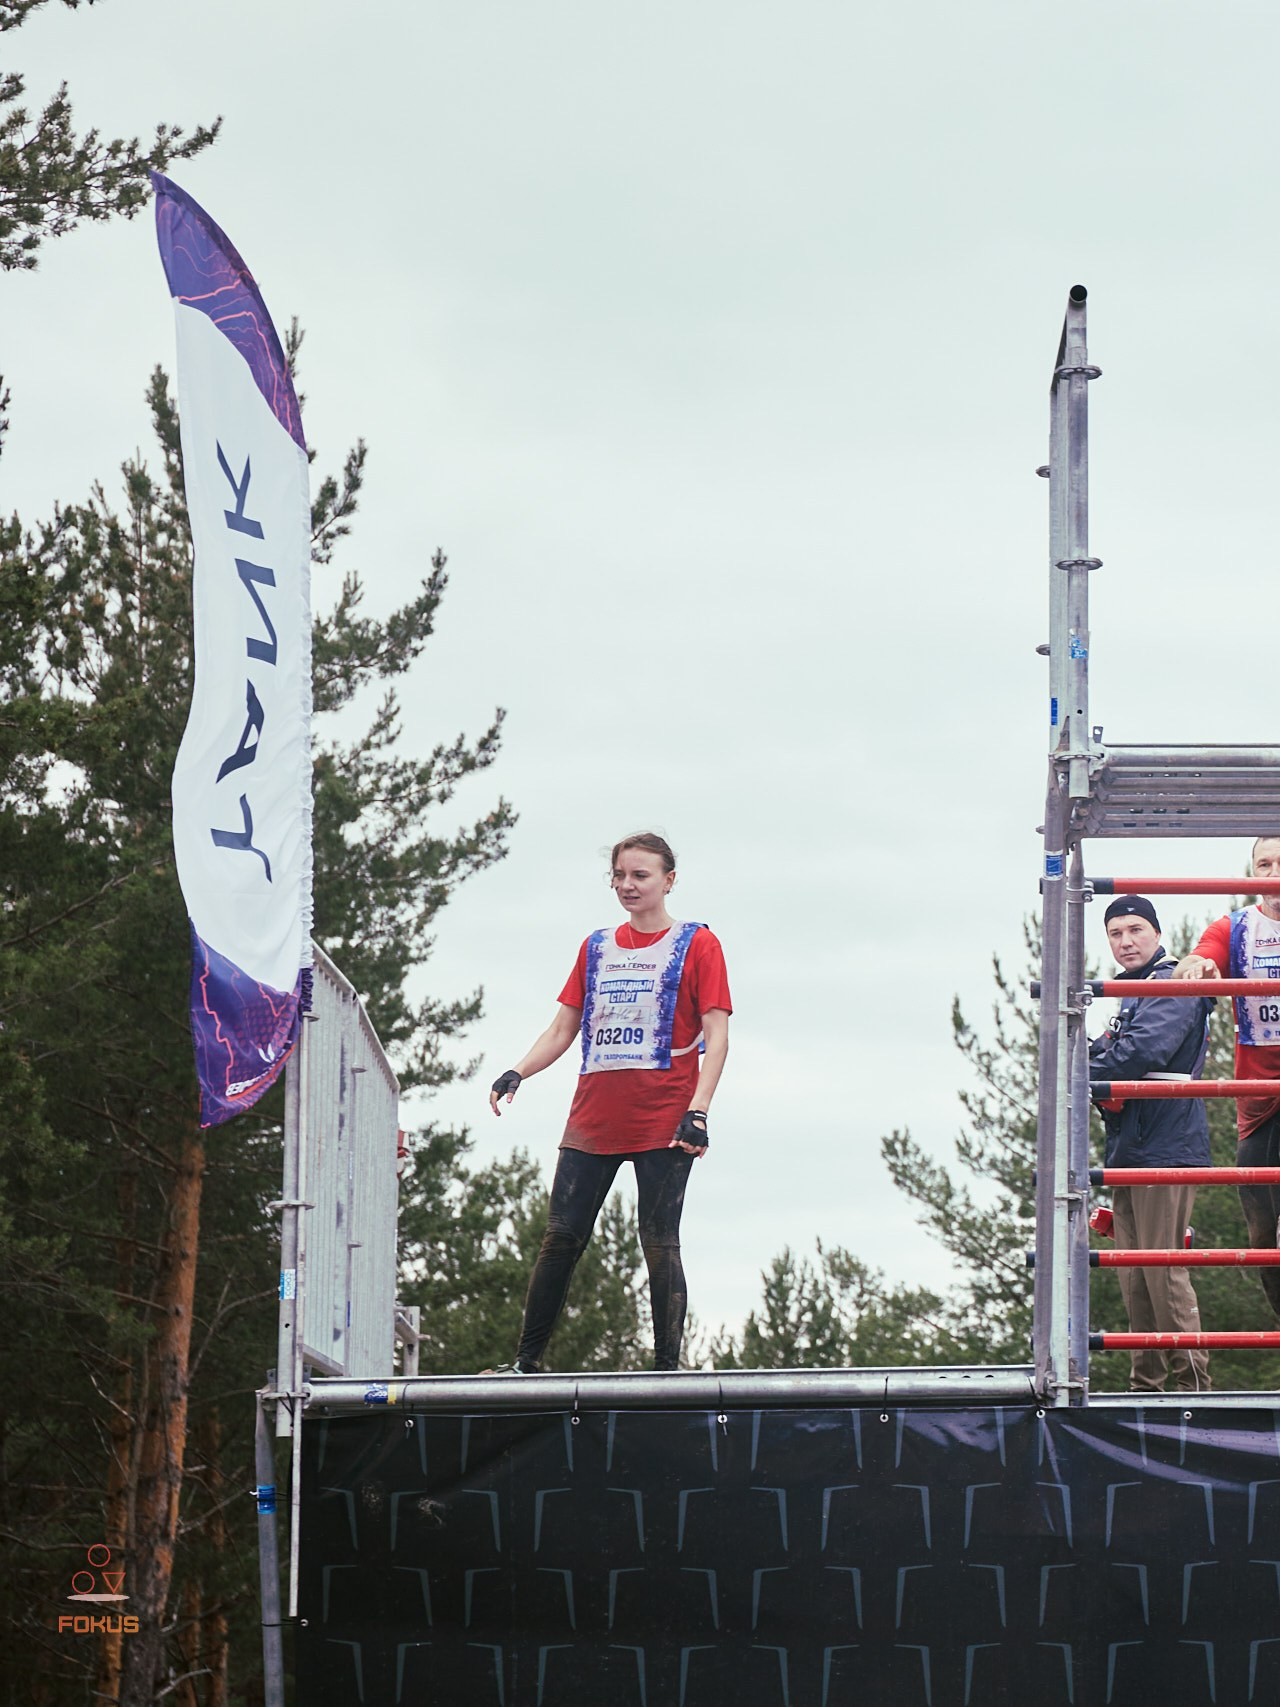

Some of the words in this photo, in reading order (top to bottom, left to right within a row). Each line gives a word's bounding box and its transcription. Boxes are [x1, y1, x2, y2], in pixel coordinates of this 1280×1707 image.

[605, 963, 627, 971] ГОНКА
[628, 962, 656, 970] ГЕРОЕВ
[600, 980, 654, 994] КОМАНДНЫЙ
[610, 992, 636, 1002] СТАРТ
[595, 1027, 644, 1046] 03209
